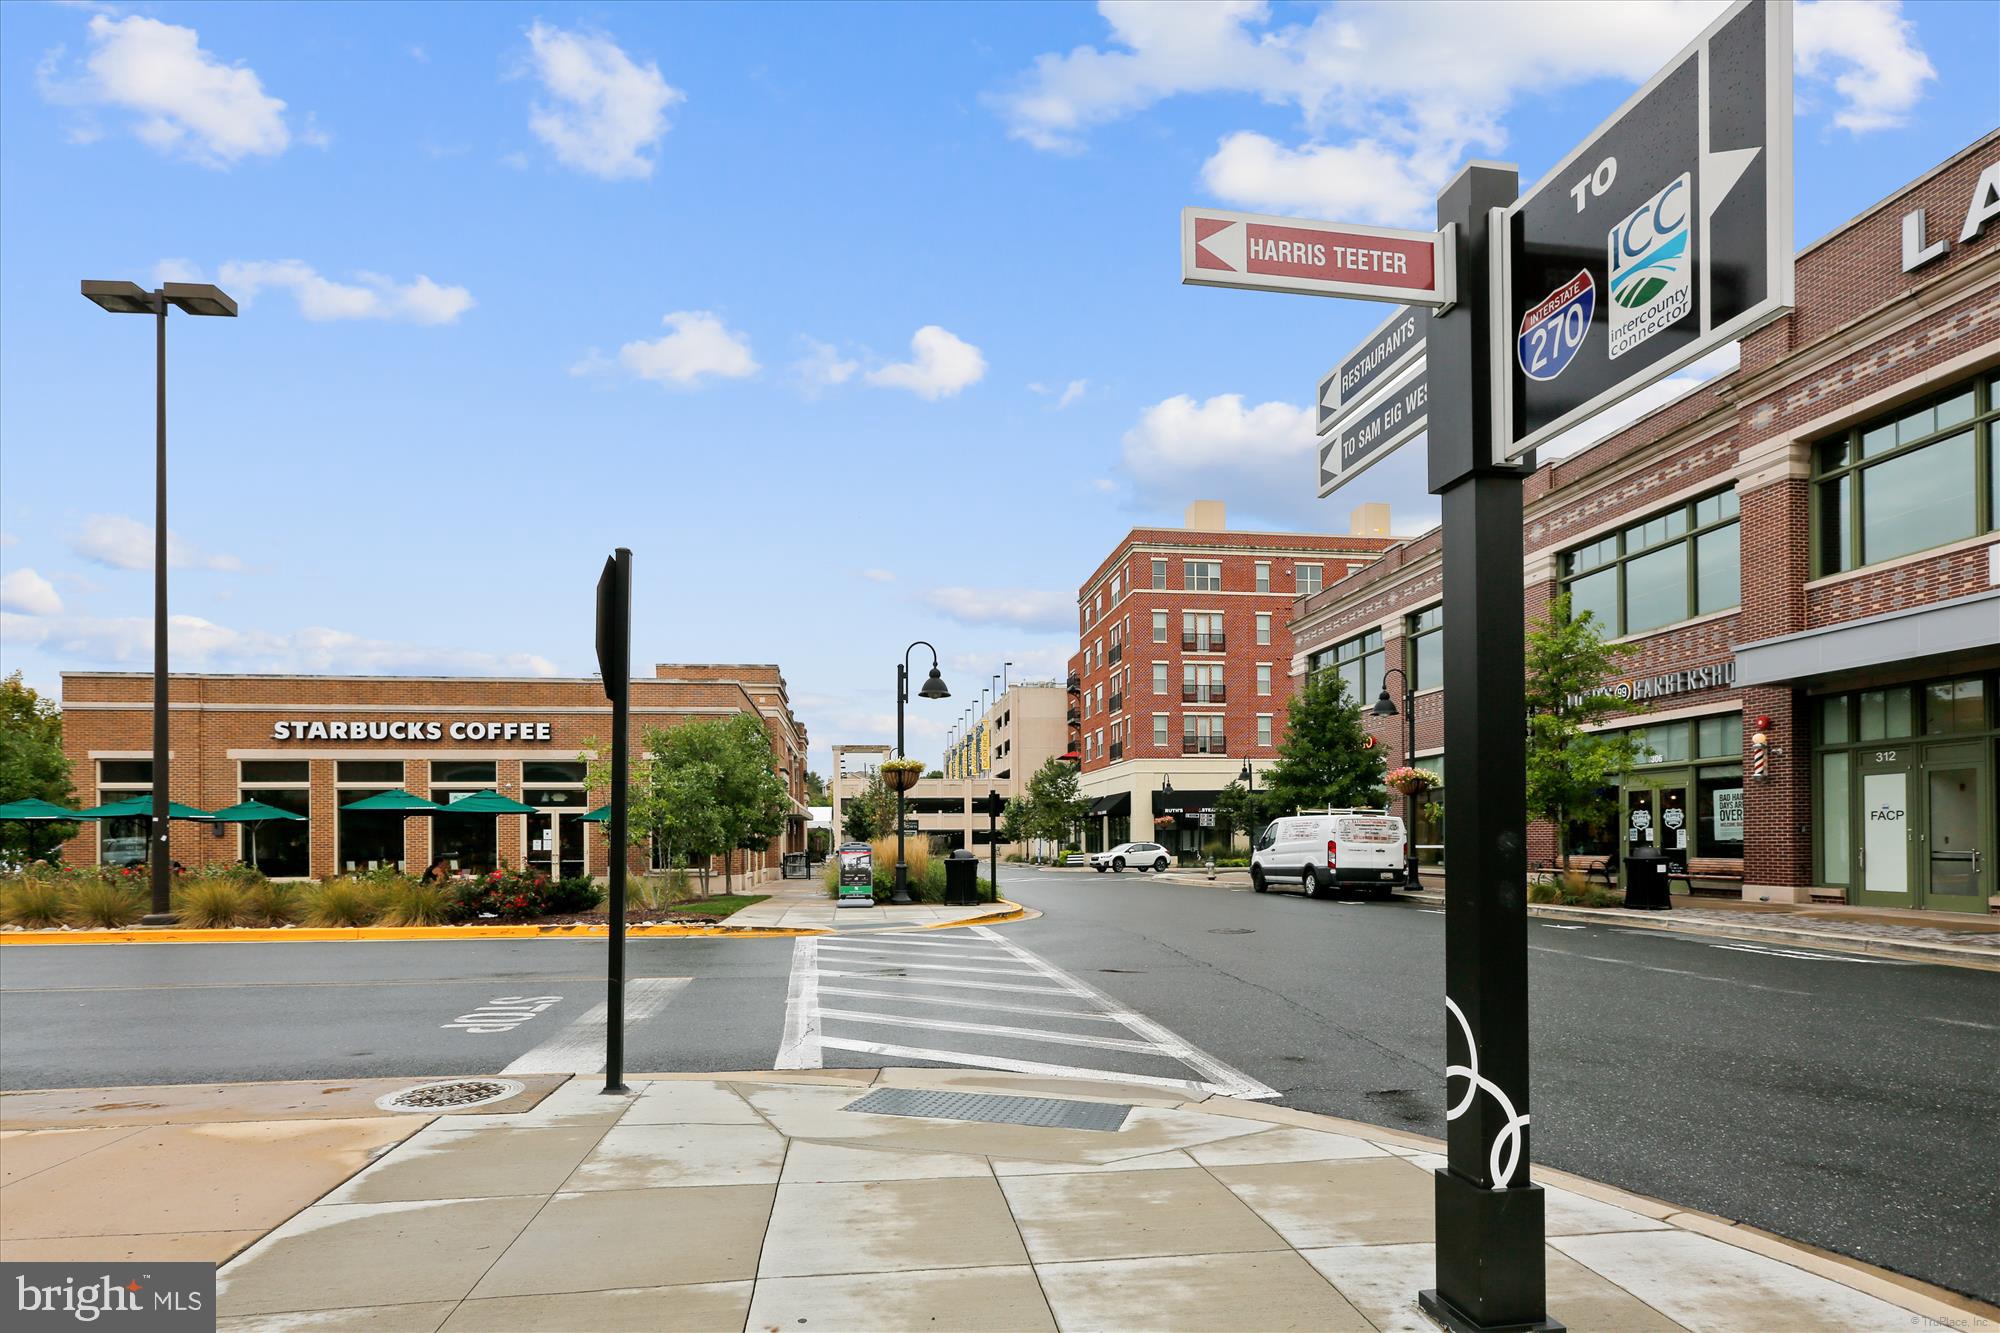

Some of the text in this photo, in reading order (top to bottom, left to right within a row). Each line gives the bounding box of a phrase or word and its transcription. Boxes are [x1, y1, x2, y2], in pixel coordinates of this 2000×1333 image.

[1570, 157, 1618, 213] TO
[1611, 180, 1686, 272] ICC
[1250, 238, 1407, 274] HARRIS TEETER
[1529, 281, 1580, 326] INTERSTATE
[1610, 285, 1689, 342] intercounty
[1530, 303, 1583, 373] 270
[1611, 301, 1689, 356] connector
[1342, 316, 1415, 394] RESTAURANTS
[1343, 437, 1356, 459] TO
[1358, 419, 1381, 449] SAM
[1384, 403, 1402, 428] EIG
[273, 721, 551, 741] STARBUCKS COFFEE
[1875, 751, 1896, 762] 312
[1719, 801, 1733, 809] DAYS
[1720, 809, 1743, 821] OVER
[1732, 793, 1744, 801] HAI
[1871, 810, 1904, 821] FACP
